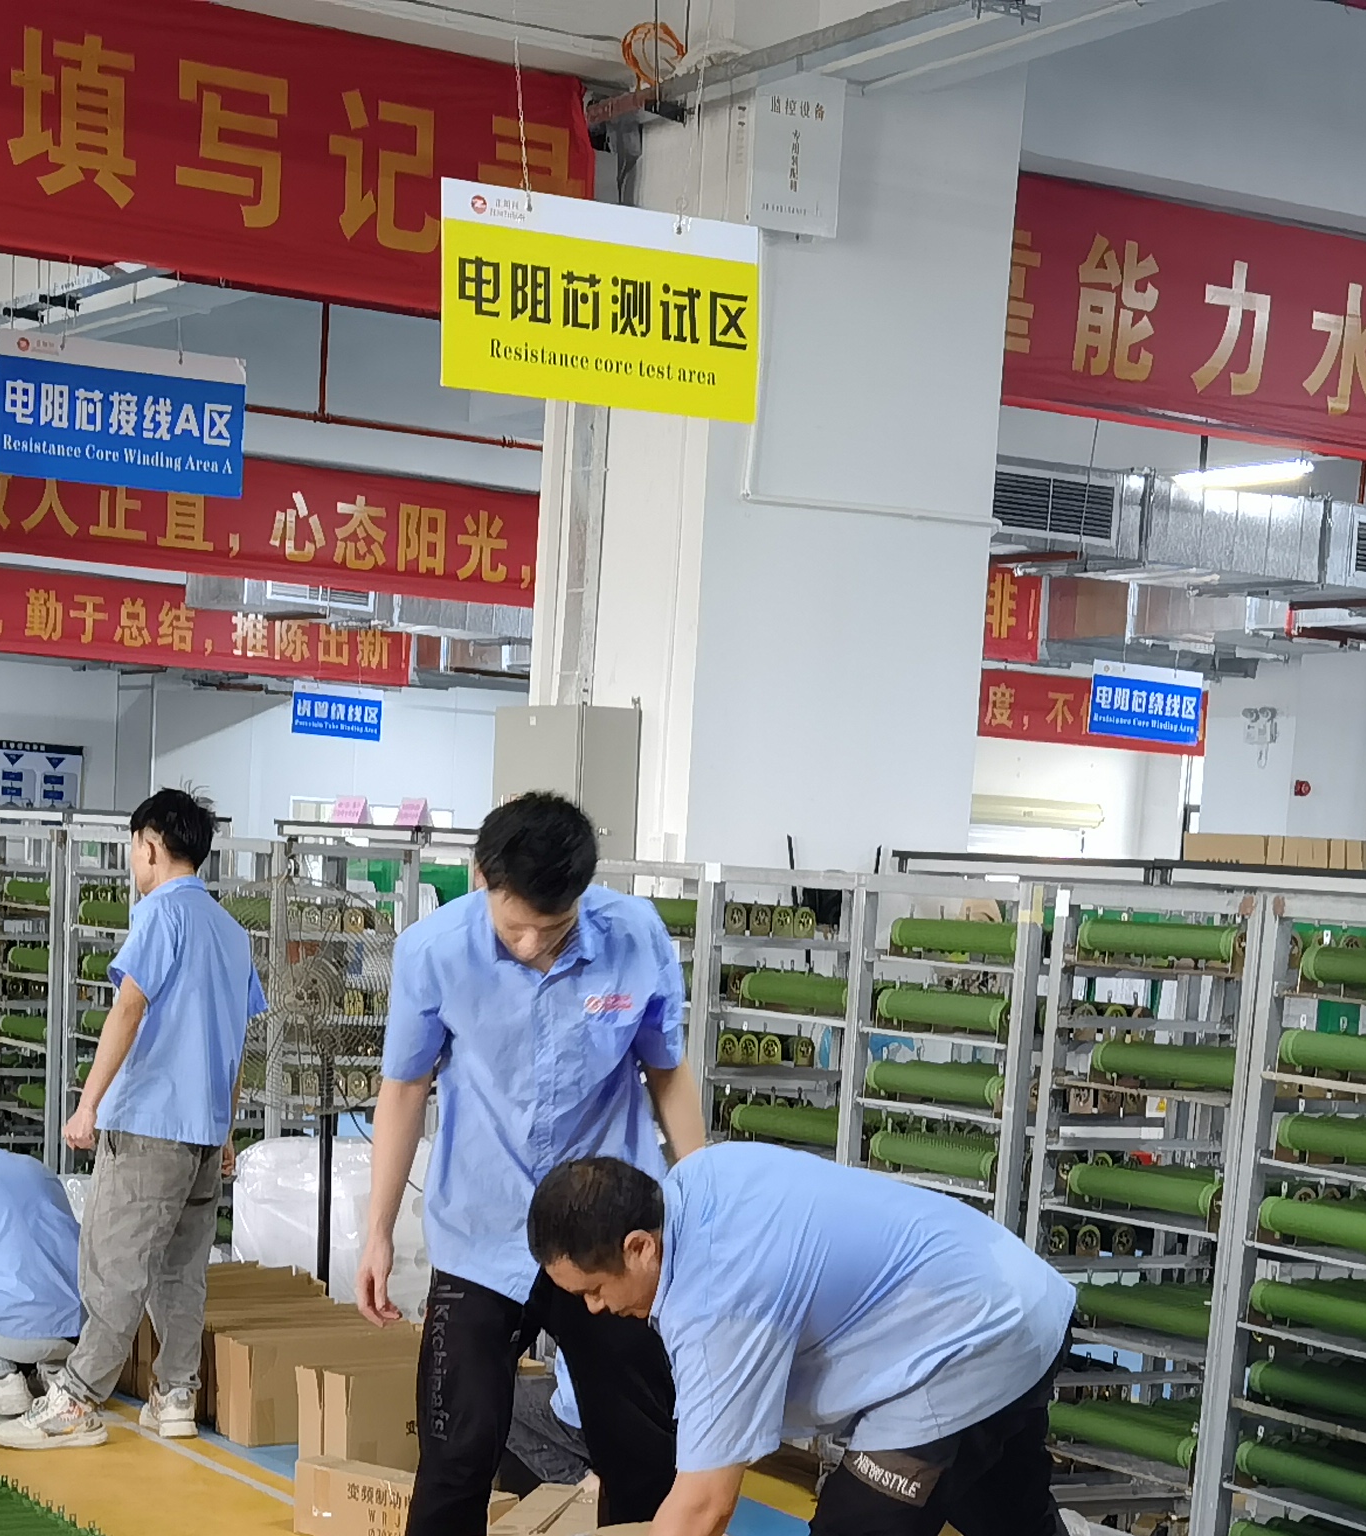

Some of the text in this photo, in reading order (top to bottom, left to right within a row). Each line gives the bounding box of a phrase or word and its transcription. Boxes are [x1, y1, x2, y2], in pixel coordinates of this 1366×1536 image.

[457, 255, 749, 351] 电阻芯测试区
[489, 338, 716, 386] Resistance core test area
[4, 378, 233, 448] 电阻芯接线A区
[2, 433, 234, 475] Resistance Core Winding Area A
